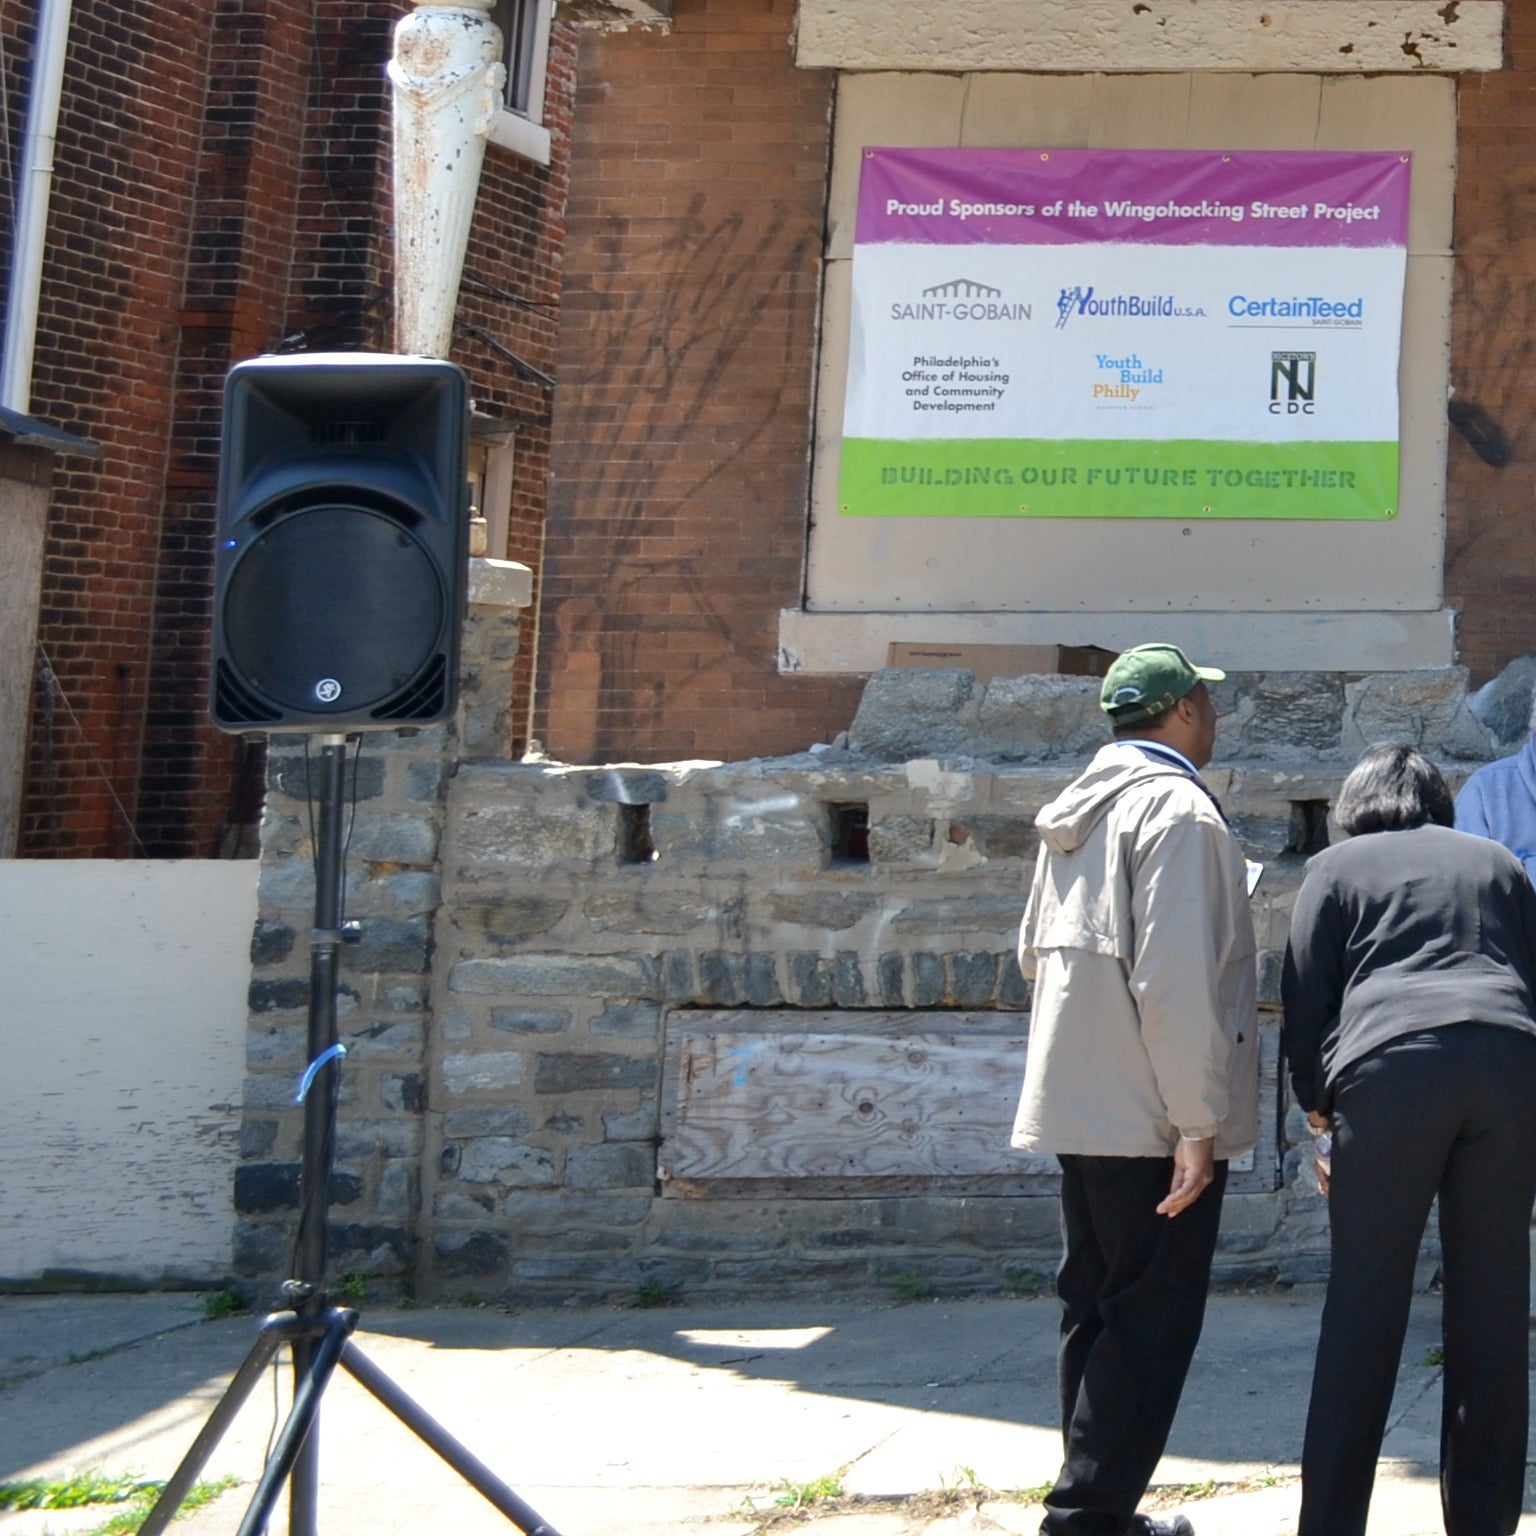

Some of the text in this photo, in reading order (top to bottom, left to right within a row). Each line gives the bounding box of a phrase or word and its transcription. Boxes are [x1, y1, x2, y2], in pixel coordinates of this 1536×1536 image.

[887, 199, 1380, 223] Proud Sponsors of the Wingohocking Street Project
[1073, 287, 1173, 316] YouthBuild
[1228, 296, 1362, 318] CertainTeed
[891, 303, 1032, 320] SAINT-GOBAIN
[913, 357, 1000, 368] Philadelphia's
[1096, 354, 1142, 369] Youth
[902, 371, 1010, 384] Office of Housing
[1120, 369, 1163, 384] Build
[905, 386, 1005, 398] and Community
[1093, 384, 1140, 402] Philly
[913, 401, 995, 413] Development
[882, 467, 1356, 489] BUILDING OUR FUTURE TOGETHER
